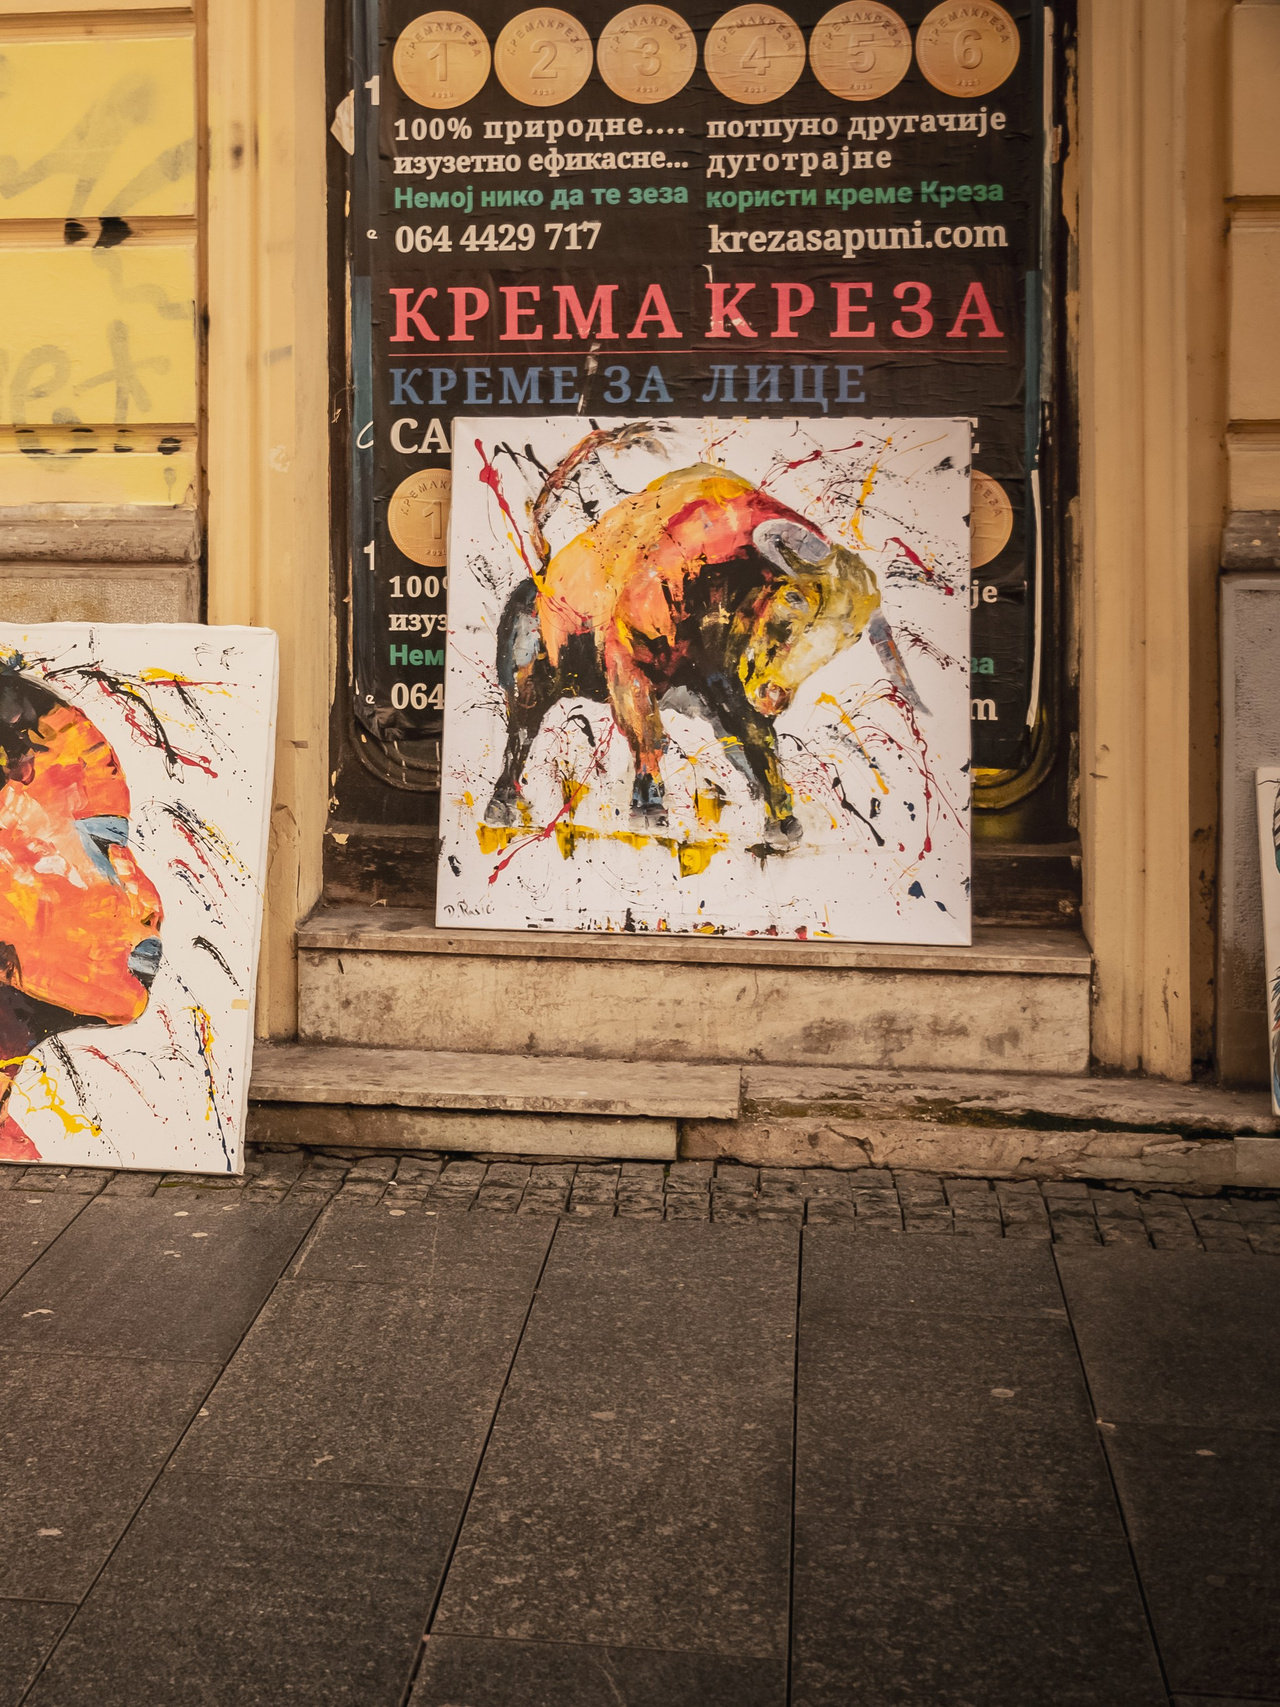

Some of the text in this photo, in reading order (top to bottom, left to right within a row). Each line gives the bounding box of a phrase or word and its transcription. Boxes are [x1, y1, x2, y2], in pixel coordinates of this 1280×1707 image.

[429, 42, 448, 81] 1
[531, 40, 558, 79] 2
[634, 37, 661, 76] 3
[741, 36, 770, 76] 4
[849, 33, 876, 73] 5
[954, 29, 983, 70] 6
[394, 116, 685, 144] 100% природне....
[706, 106, 1006, 143] потпуно другачије
[393, 148, 689, 180] изузетно ефикасне...
[706, 145, 892, 179] дуготрајне
[394, 185, 688, 213] Немој нико да те зеза
[706, 181, 1004, 213] користи креме Креза
[395, 220, 602, 253] 064 4429 717
[708, 219, 1009, 259] krezasapuni.com
[389, 281, 1004, 342] КРЕМА КРЕЗА
[389, 365, 866, 413] КРЕМЕ ЗА ЛИЦЕ
[388, 614, 447, 638] изуз
[389, 644, 444, 666] Нем
[391, 682, 445, 710] 064
